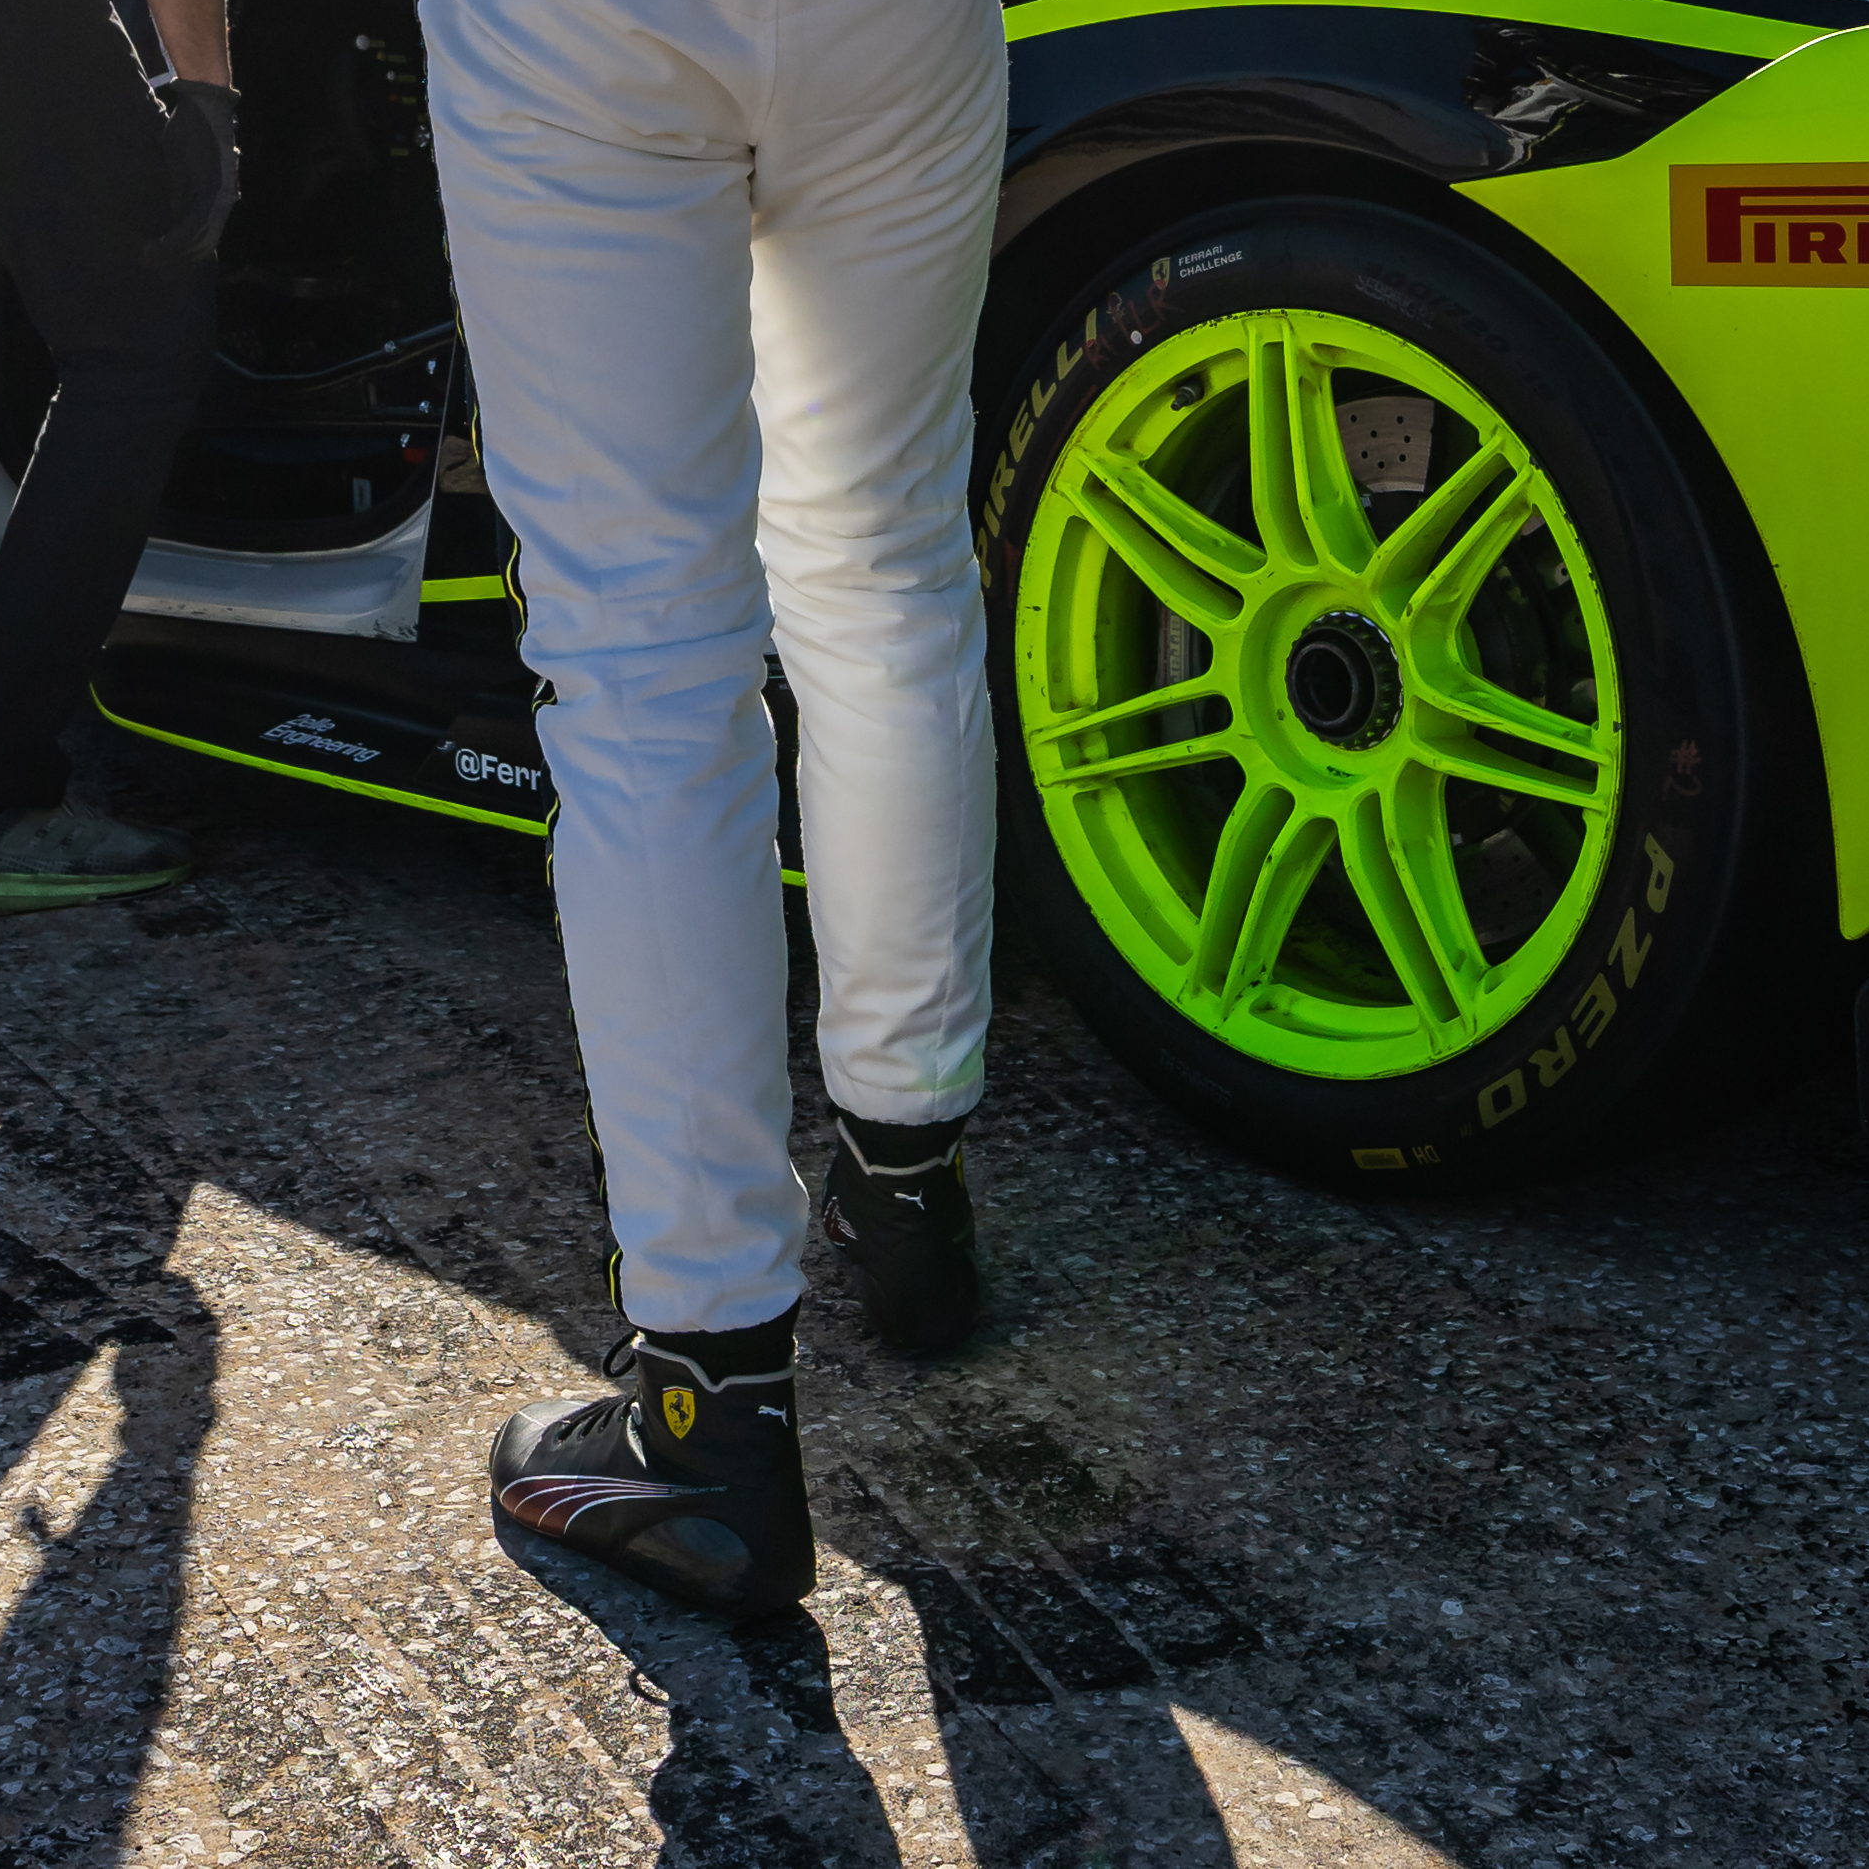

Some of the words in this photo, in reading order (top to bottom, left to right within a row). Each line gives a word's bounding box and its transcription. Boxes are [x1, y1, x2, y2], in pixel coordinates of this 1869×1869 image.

[1178, 245, 1223, 267] FERRARI
[1179, 250, 1243, 278] CHALLENGE
[975, 307, 1097, 589] PIRELLI
[262, 724, 381, 762] Engineering
[455, 748, 541, 791] @Ferr
